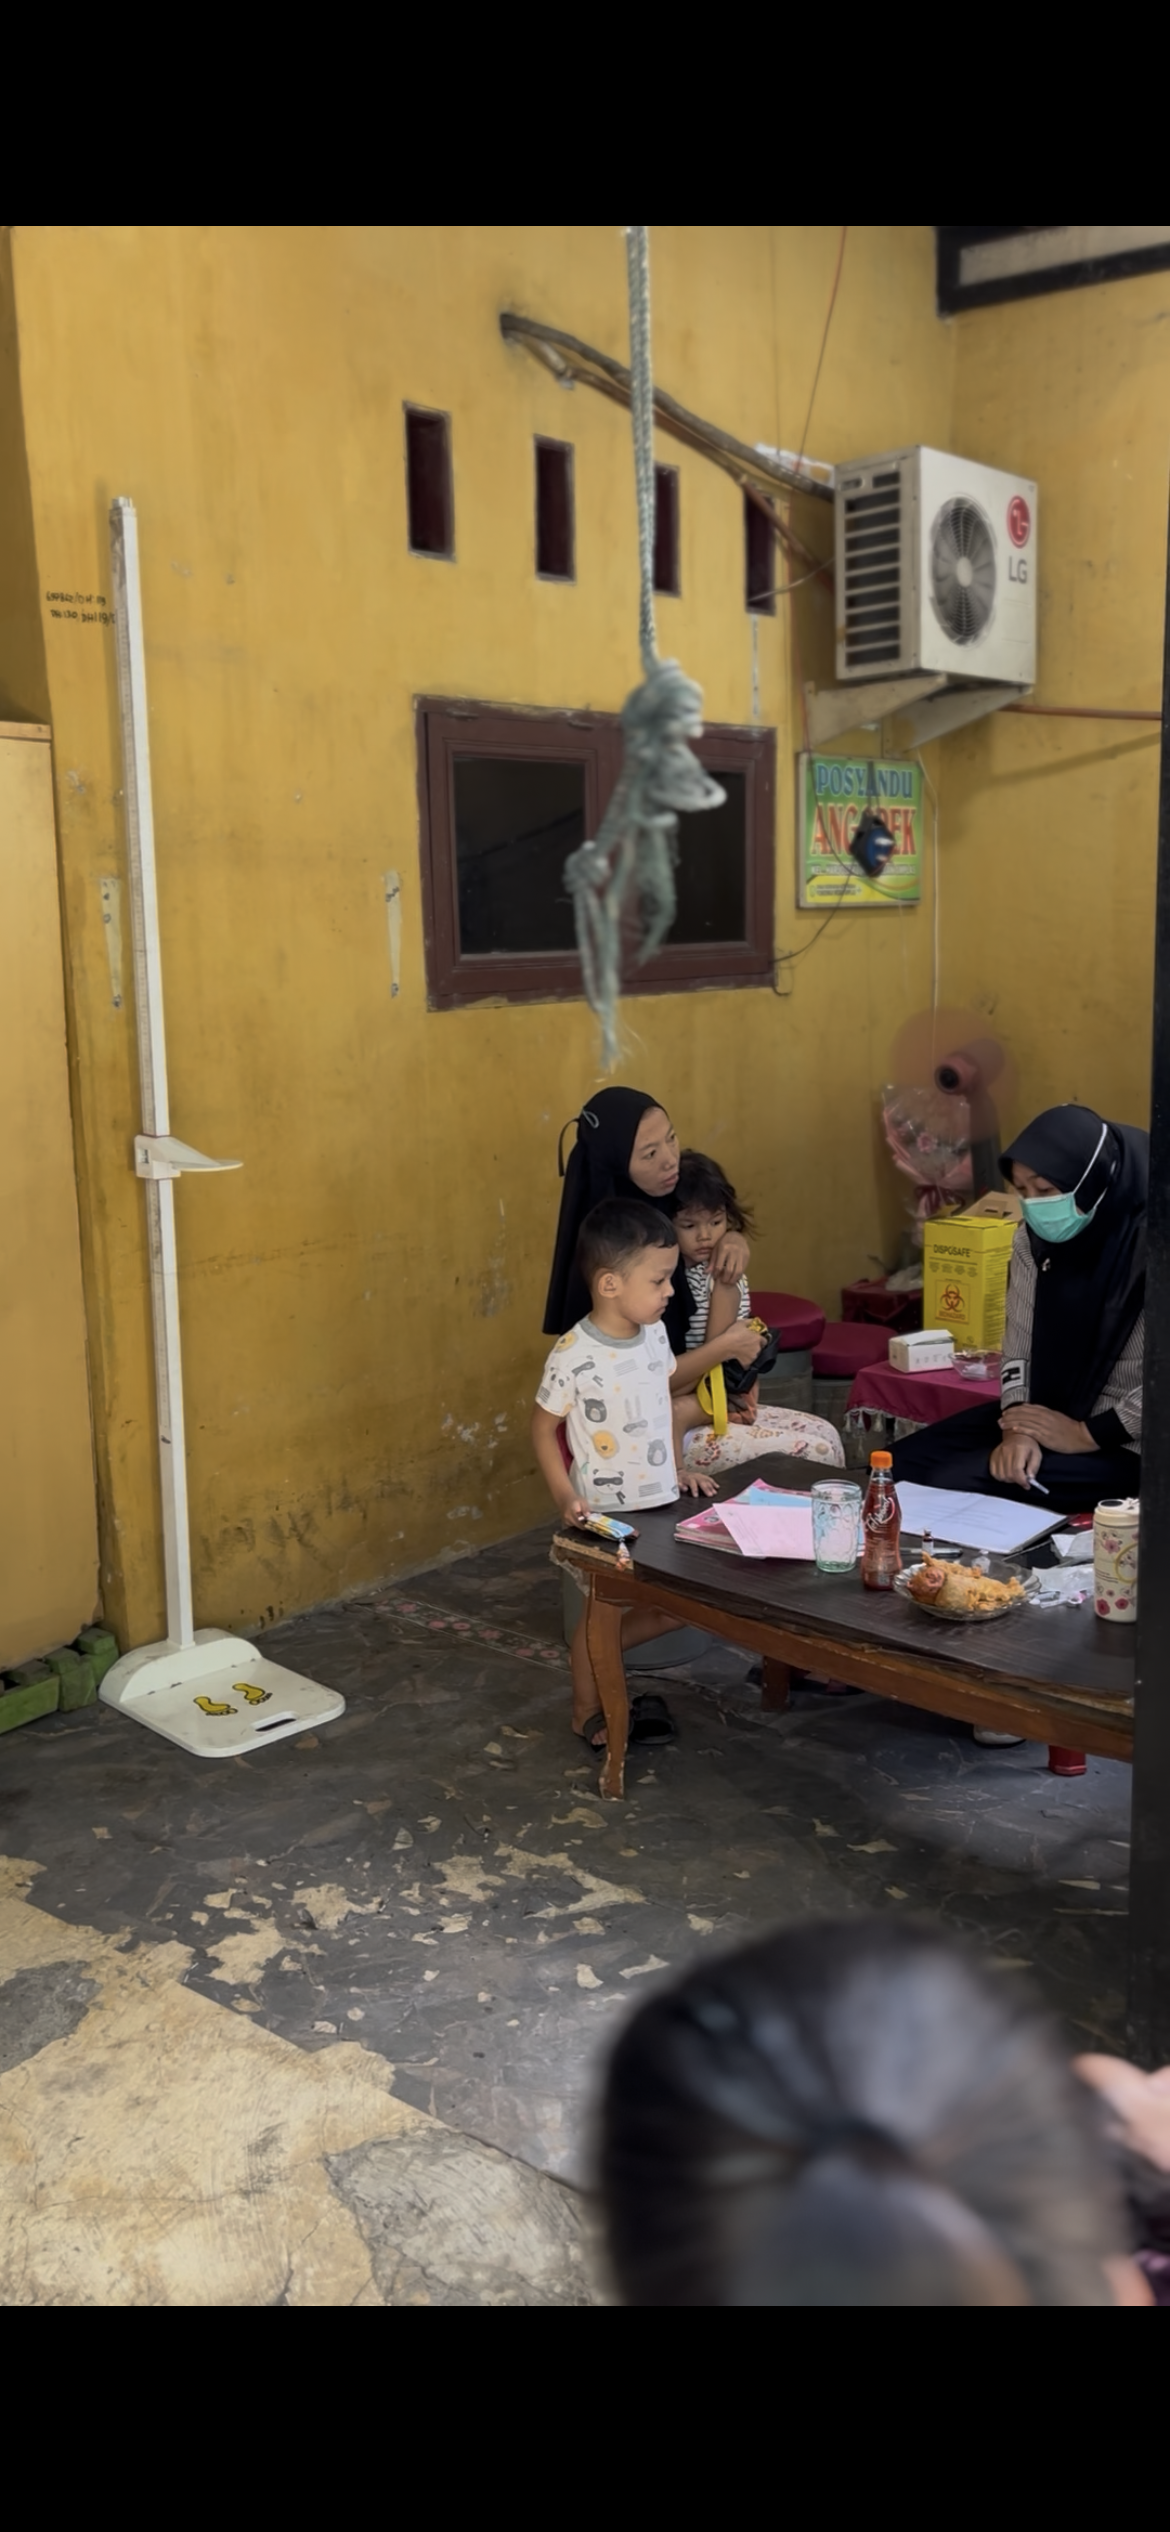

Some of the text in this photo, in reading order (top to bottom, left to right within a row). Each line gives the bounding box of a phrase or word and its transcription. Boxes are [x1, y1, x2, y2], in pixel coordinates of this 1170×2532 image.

[1009, 556, 1028, 584] LG
[815, 765, 914, 798] POSYANDU
[811, 804, 917, 856] ANGEK
[933, 1244, 971, 1258] DISPOSAFE
